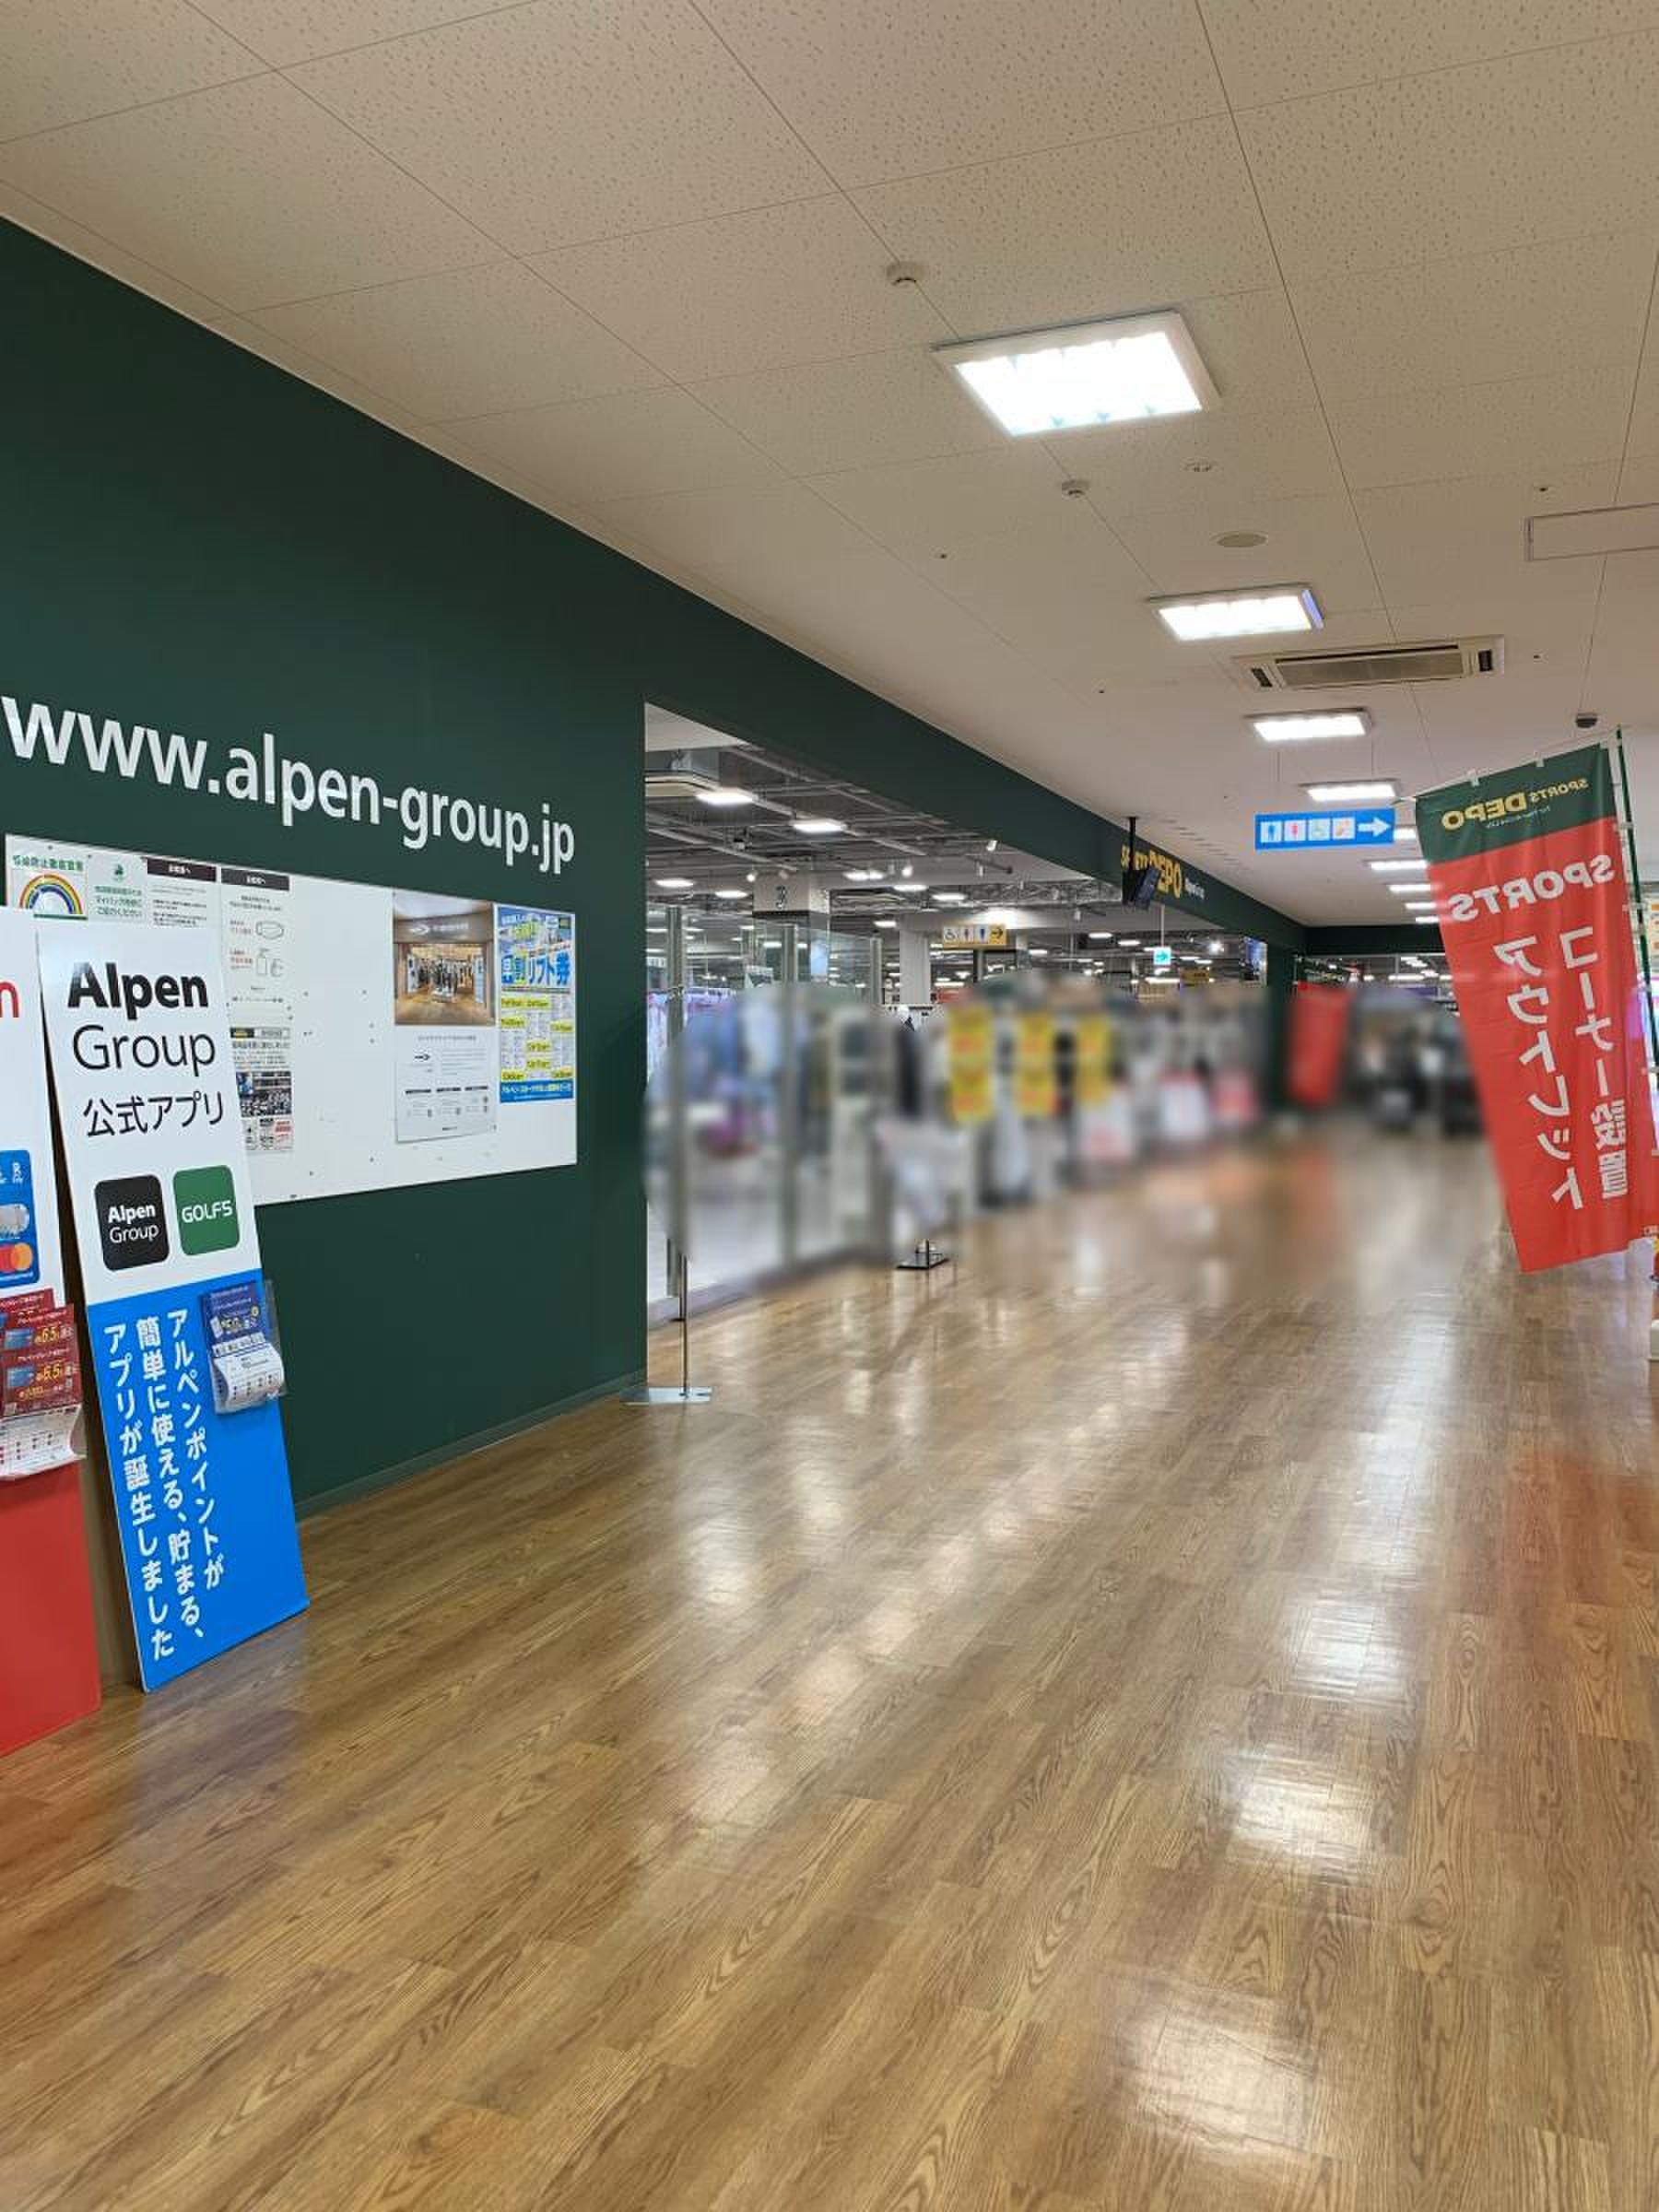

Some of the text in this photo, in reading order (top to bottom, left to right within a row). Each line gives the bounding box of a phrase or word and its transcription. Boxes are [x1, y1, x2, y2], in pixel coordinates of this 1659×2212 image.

[2, 696, 575, 874] www.alpen-group.jp
[67, 961, 209, 1020] Alpen
[73, 1024, 216, 1077] Group
[83, 1091, 224, 1137] 公式アプリ
[108, 1204, 157, 1225] Alpen
[109, 1224, 159, 1243] Group
[182, 1200, 233, 1223] GOLF5
[135, 1316, 204, 1639] 簡単に使える、貯まる、
[167, 1309, 224, 1590] アルペンポイントが
[103, 1324, 175, 1662] アプリが誕生しました
